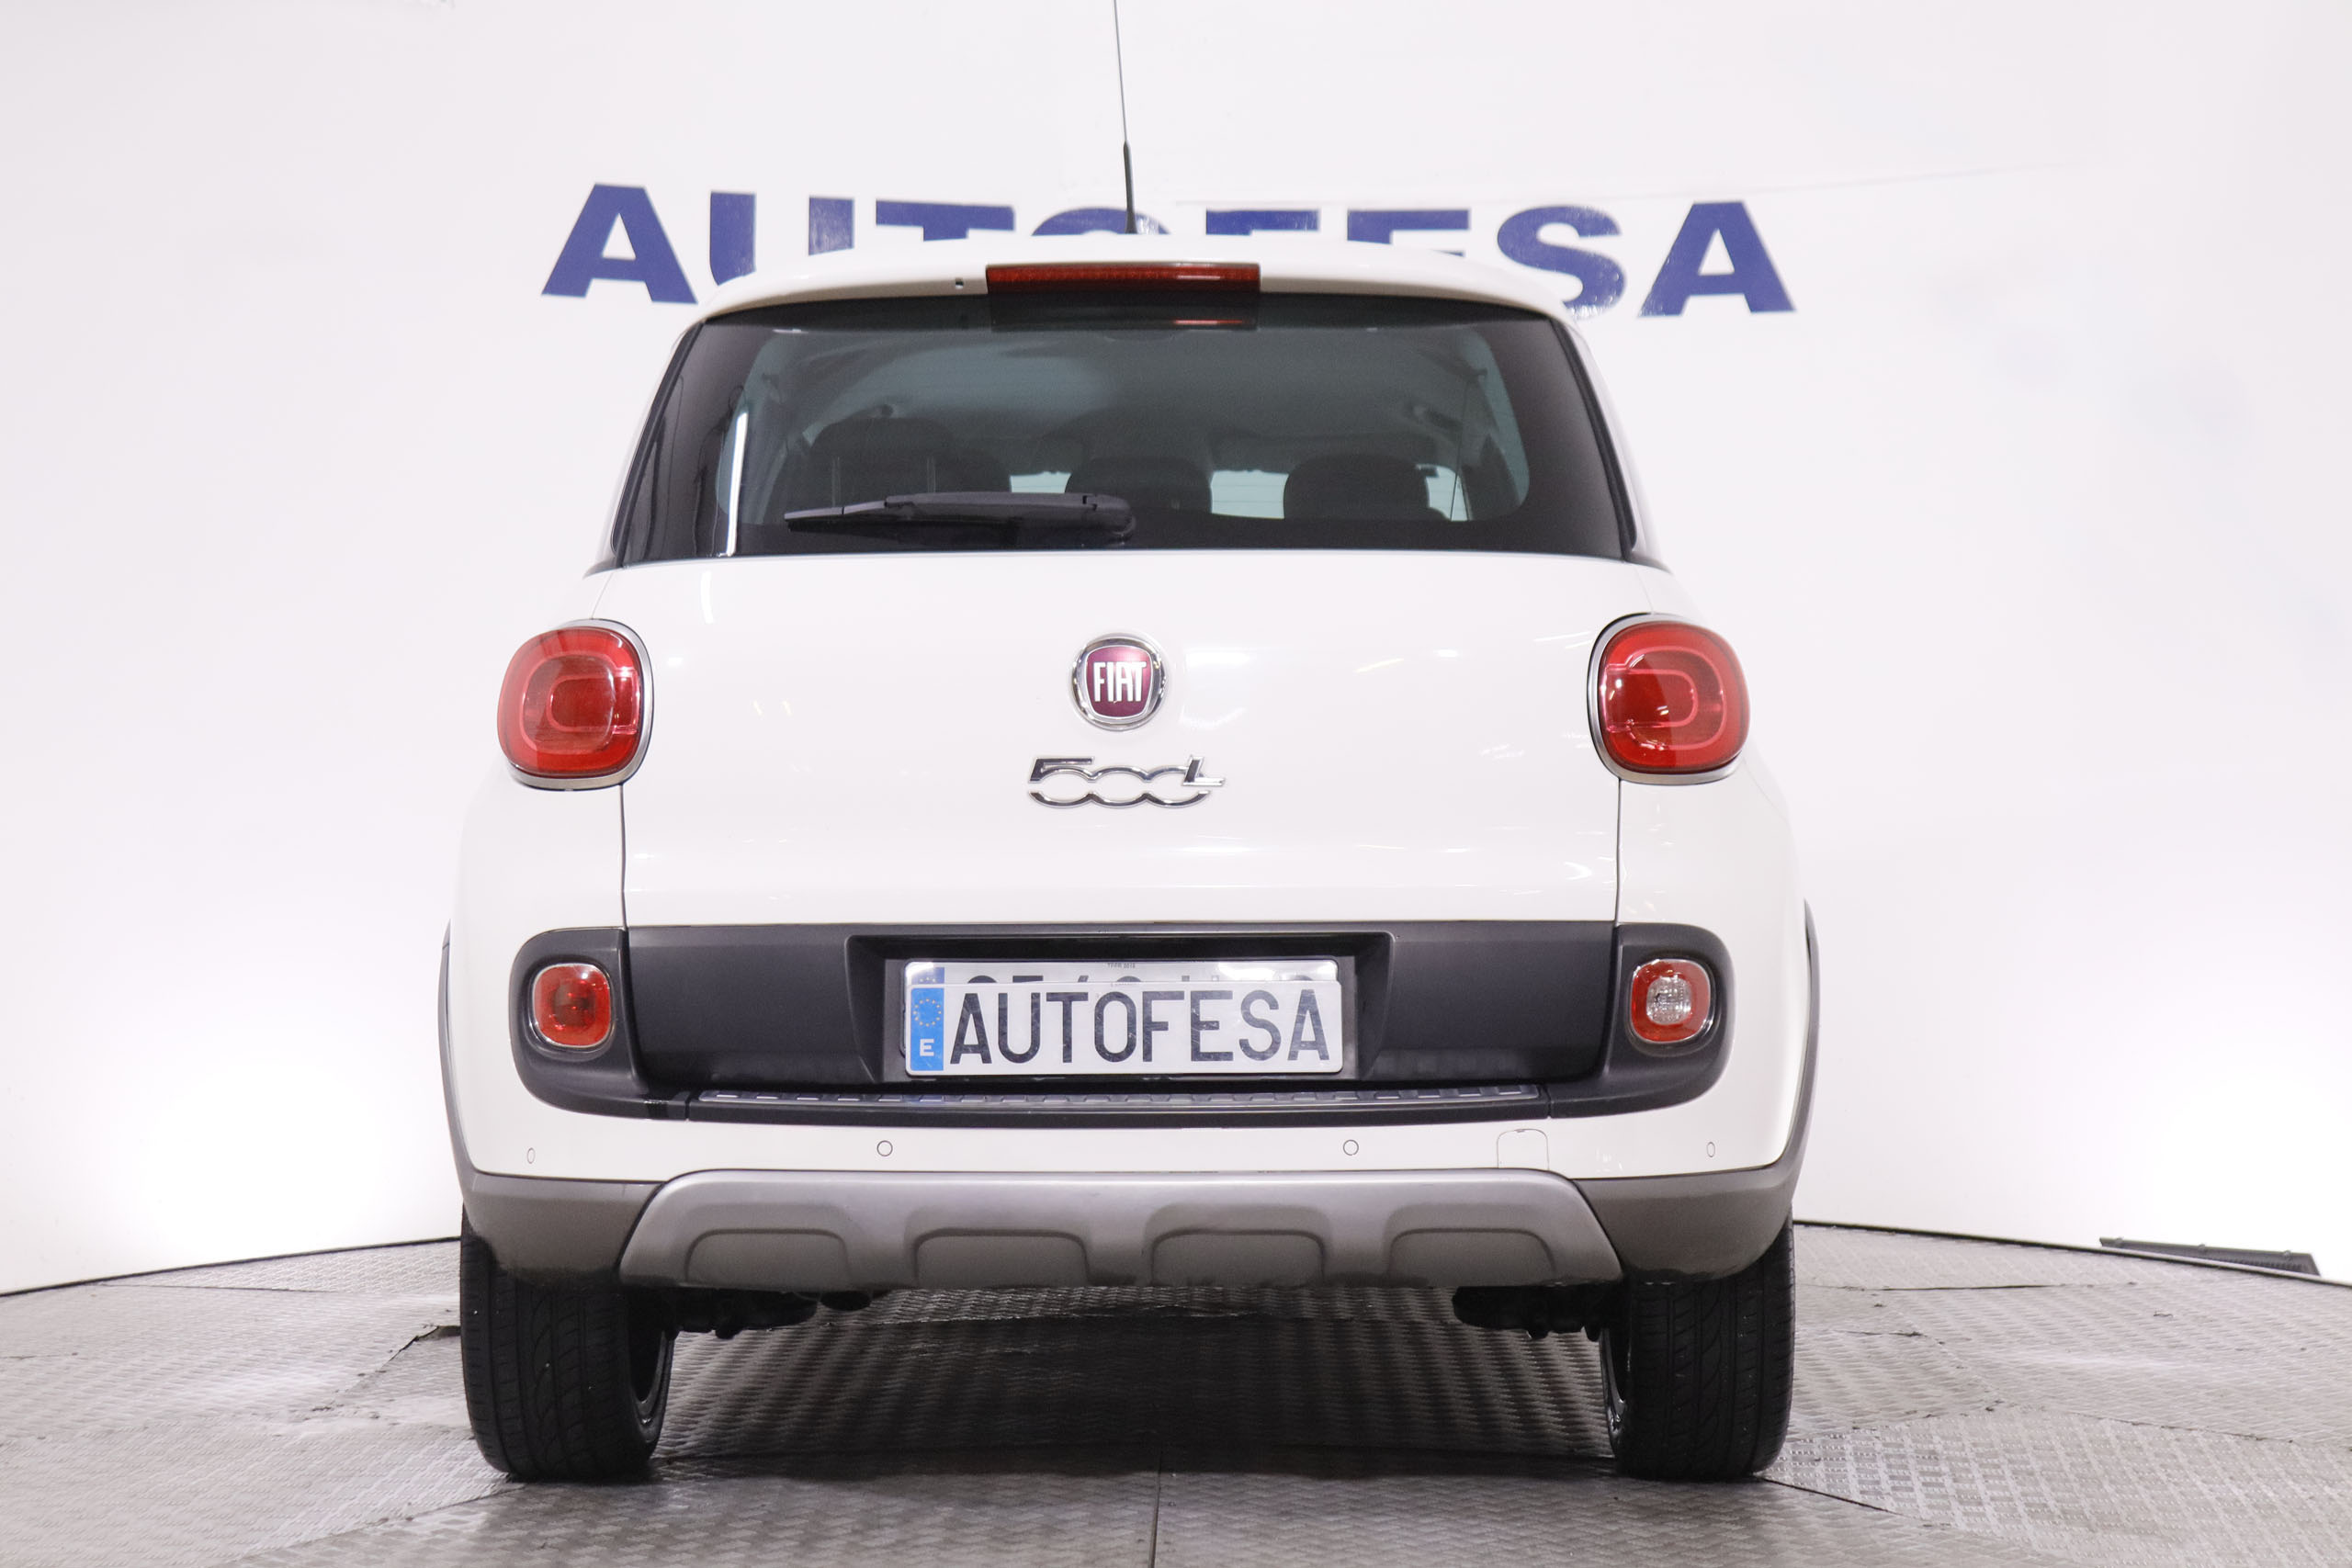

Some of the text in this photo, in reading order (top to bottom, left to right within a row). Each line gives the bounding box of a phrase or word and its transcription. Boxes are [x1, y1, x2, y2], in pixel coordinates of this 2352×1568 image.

[1093, 661, 1147, 702] FIAT
[1027, 755, 1226, 808] 500L
[920, 1038, 934, 1056] E
[950, 989, 1330, 1064] AUTOFESA
